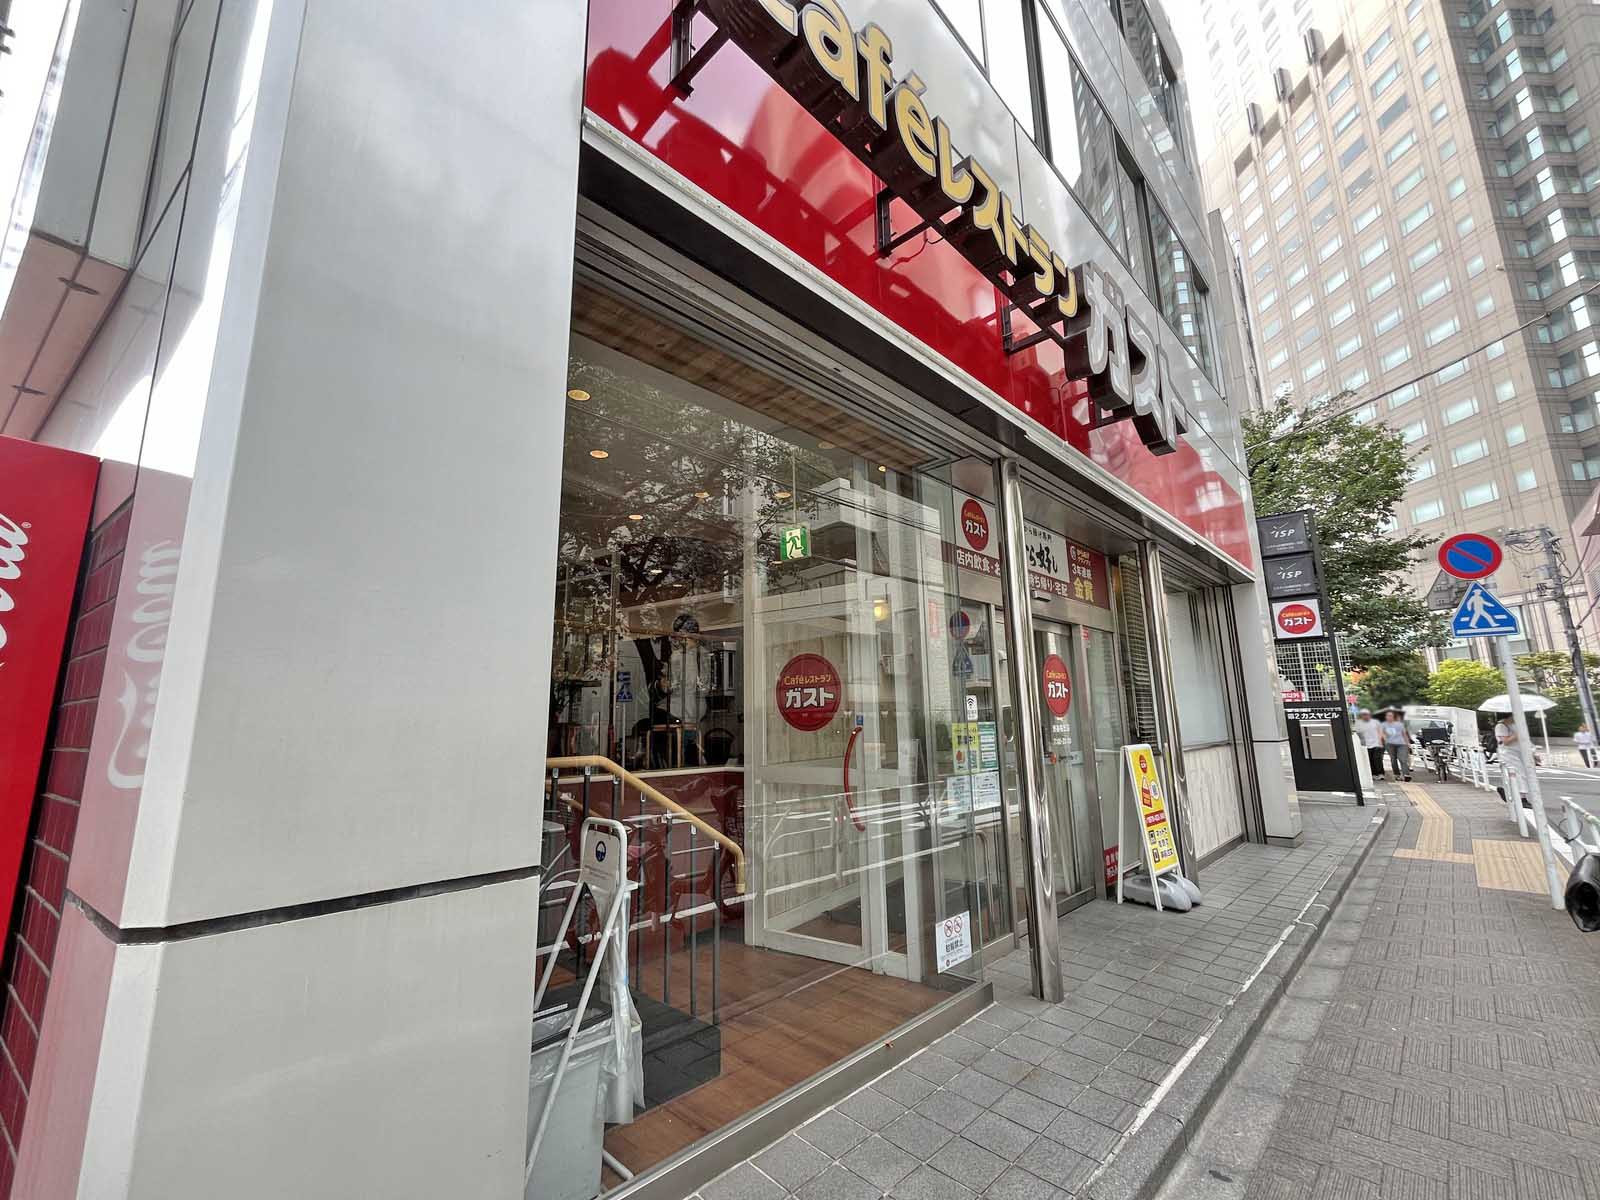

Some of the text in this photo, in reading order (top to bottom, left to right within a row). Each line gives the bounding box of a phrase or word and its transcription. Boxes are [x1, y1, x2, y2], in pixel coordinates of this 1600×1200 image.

[758, 0, 1078, 318] aféレストラン
[1083, 261, 1188, 452] ガスト
[965, 519, 987, 538] ガスト
[1026, 542, 1058, 574] ら好し
[1284, 616, 1313, 627] ガスト
[783, 674, 832, 686] Caféレストラン
[1047, 681, 1069, 699] ガスト
[785, 687, 834, 709] ガスト
